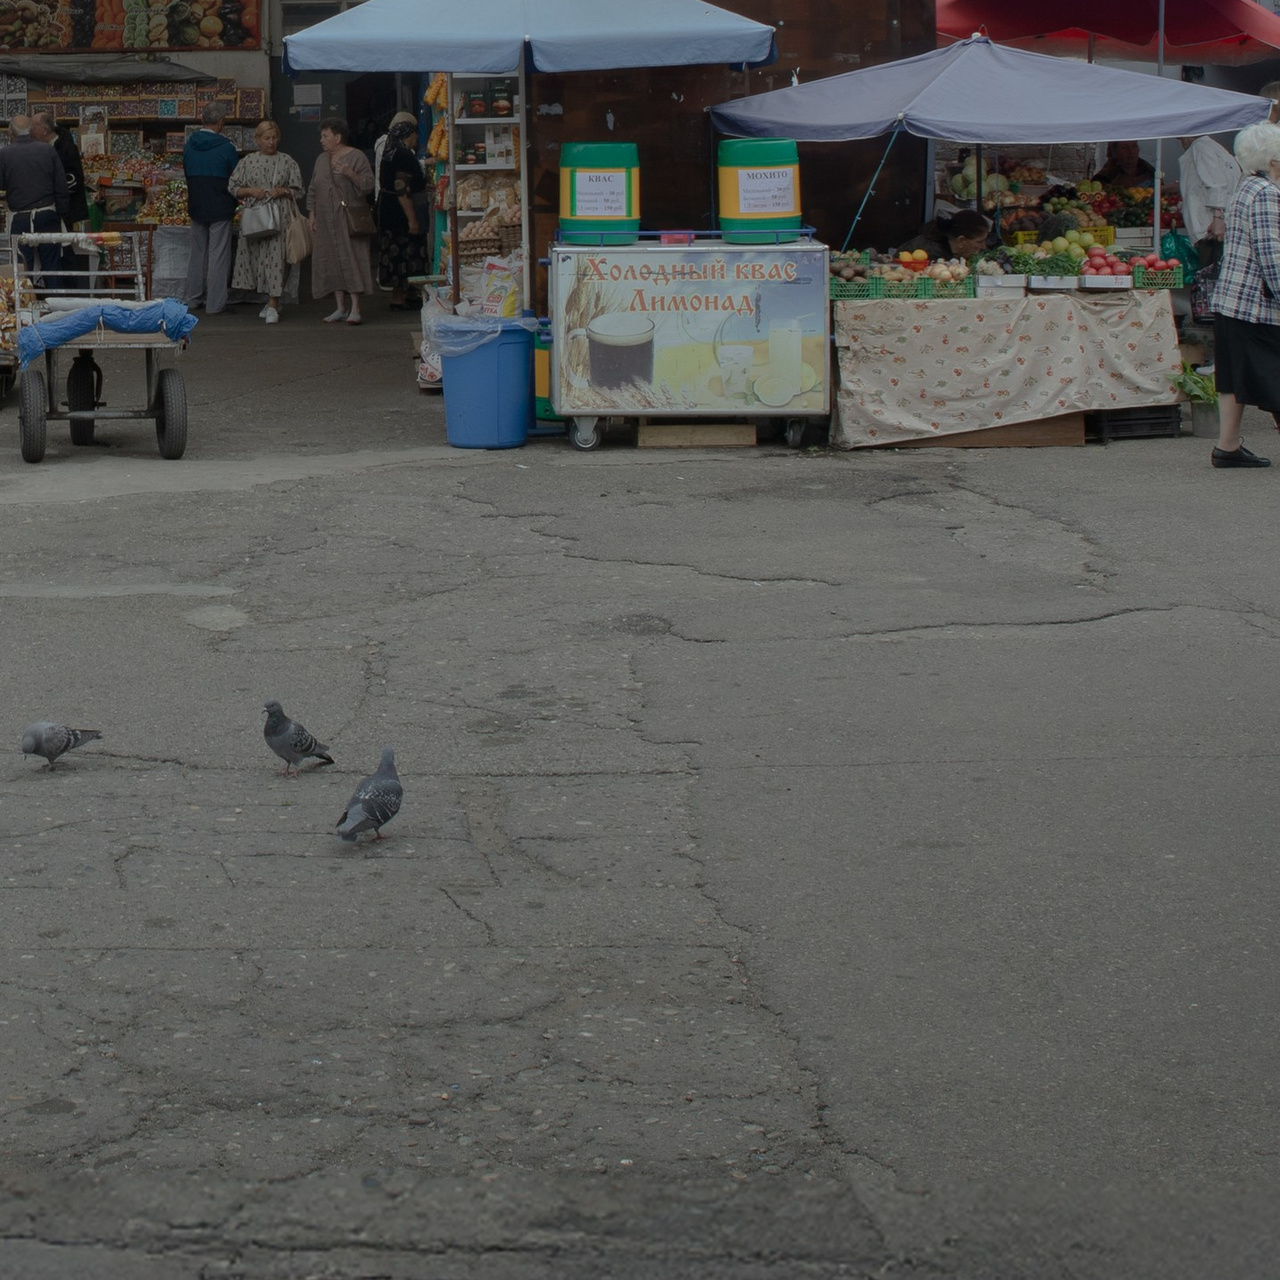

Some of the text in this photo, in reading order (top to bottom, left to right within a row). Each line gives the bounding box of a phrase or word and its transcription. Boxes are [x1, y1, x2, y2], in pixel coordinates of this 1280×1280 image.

[588, 175, 614, 183] КВАС
[747, 171, 788, 180] МОХИТО
[586, 258, 798, 285] Холодный квас
[629, 288, 756, 316] Лимонад
